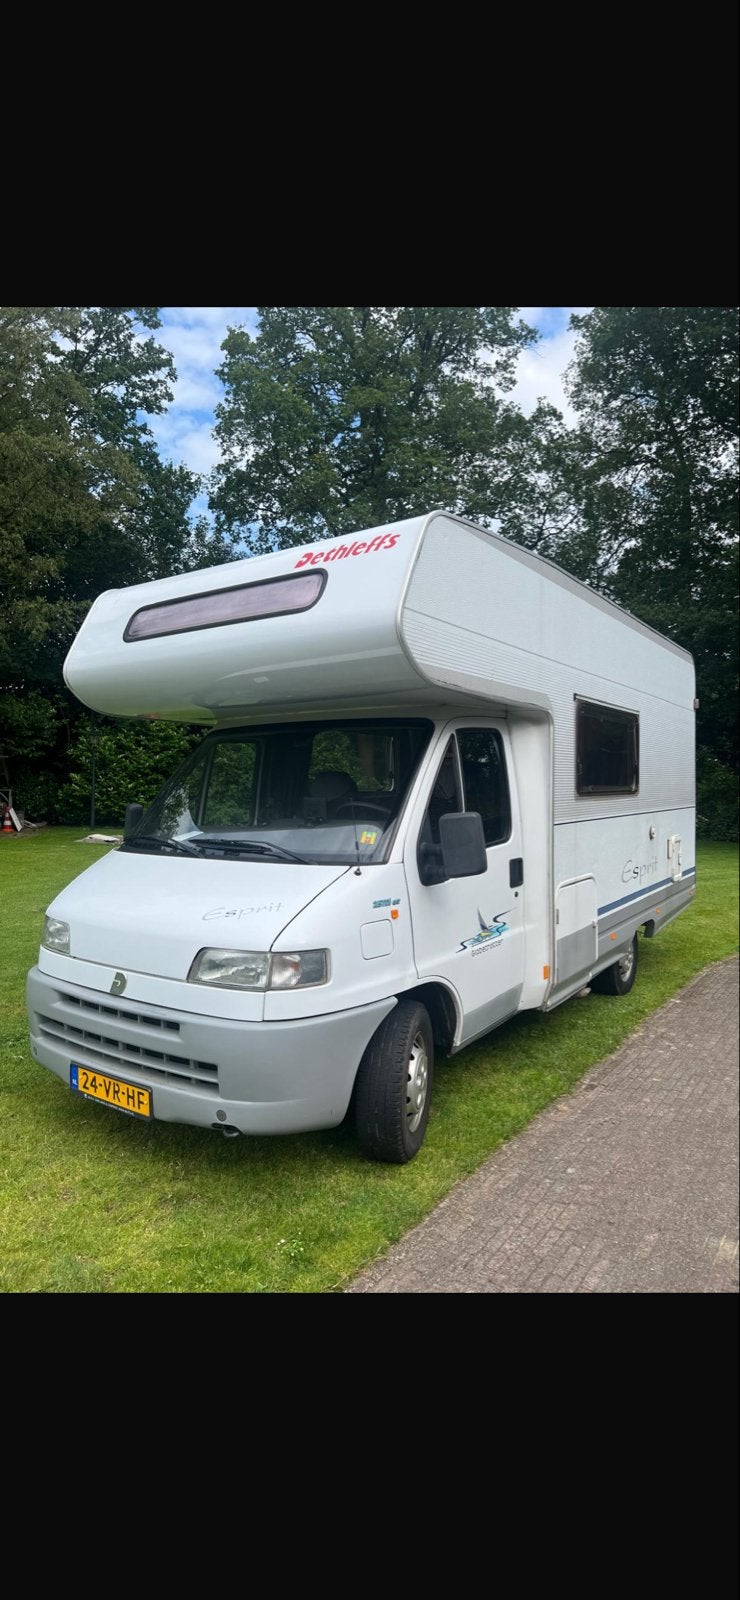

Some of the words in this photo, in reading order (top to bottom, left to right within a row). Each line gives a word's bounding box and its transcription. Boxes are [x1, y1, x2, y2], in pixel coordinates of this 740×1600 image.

[621, 856, 658, 885] Esprit
[202, 902, 284, 921] Esprit
[82, 1071, 145, 1110] 24-VR-HF
